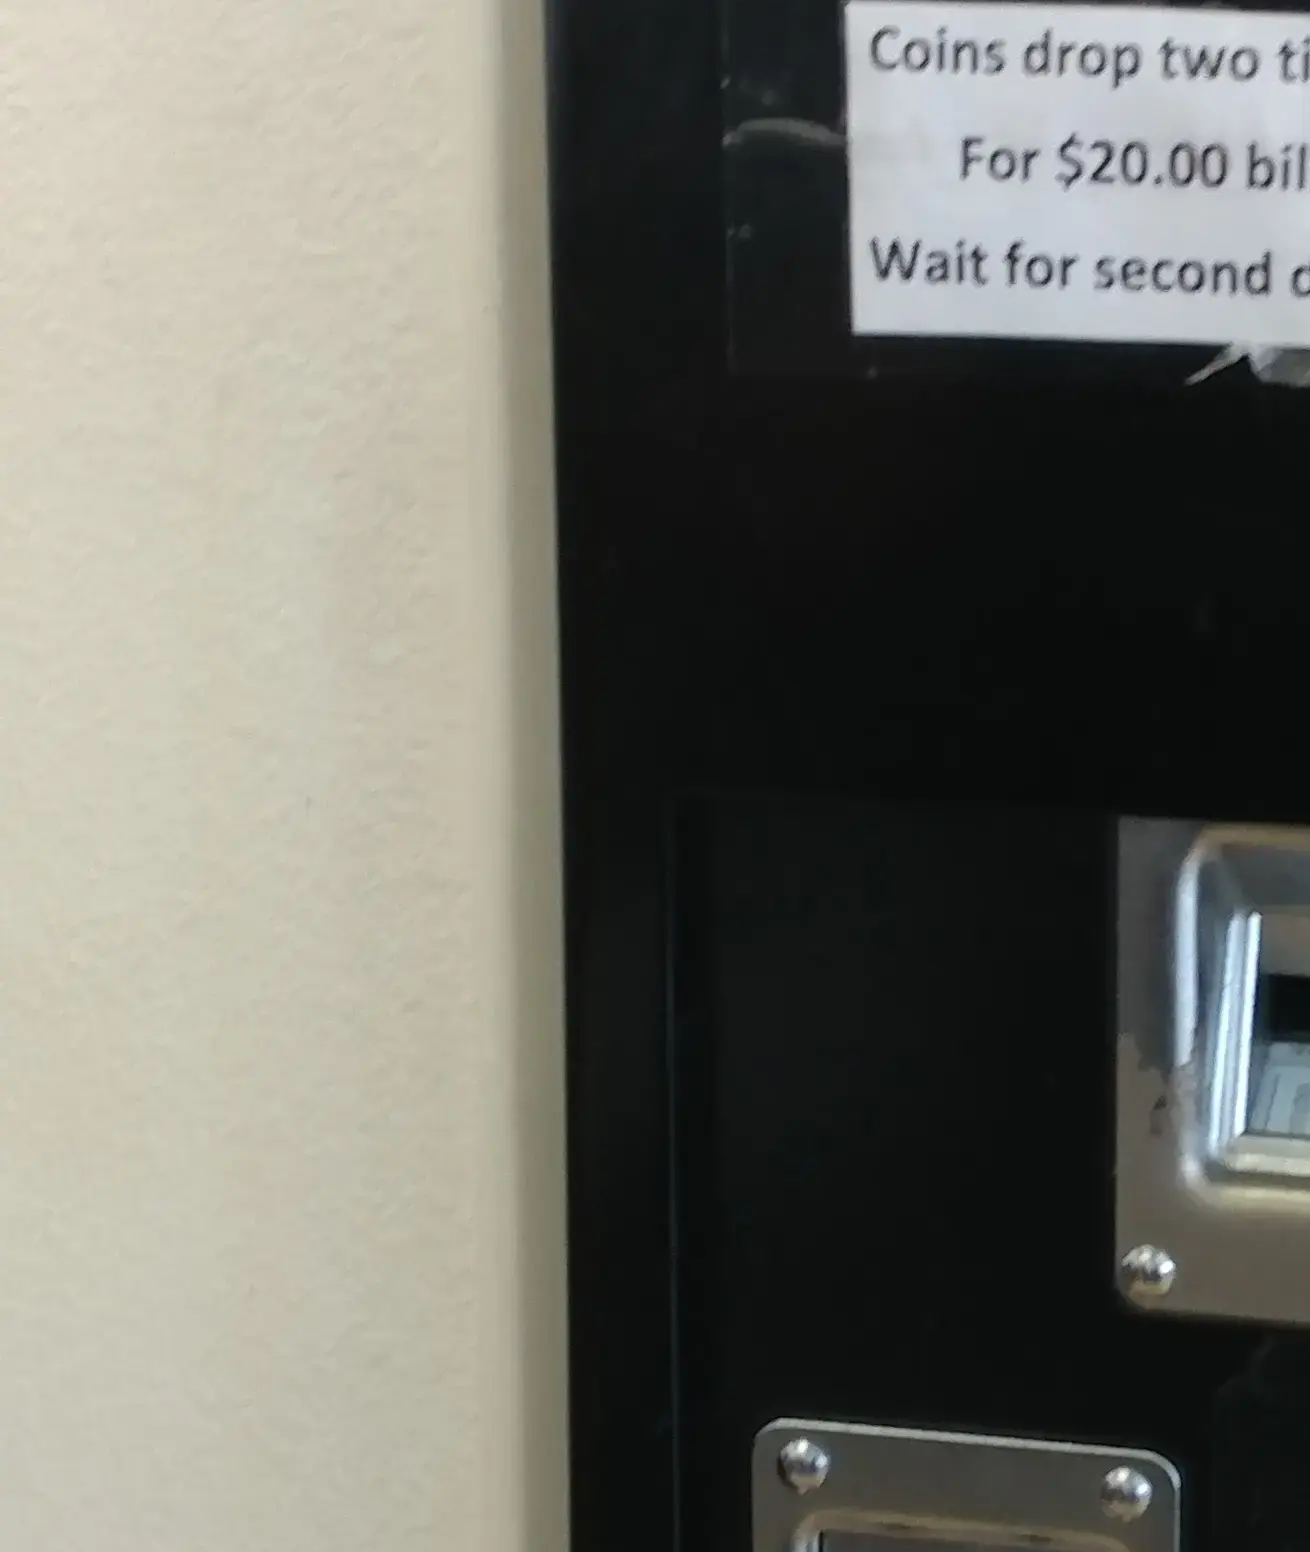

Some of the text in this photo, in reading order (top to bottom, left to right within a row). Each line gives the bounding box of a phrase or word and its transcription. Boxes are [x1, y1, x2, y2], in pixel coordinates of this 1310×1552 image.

[870, 27, 1005, 74] Coins
[1023, 30, 1140, 89] drop
[1160, 39, 1259, 81] two
[960, 137, 1040, 181] For
[1056, 133, 1229, 190] $20.00
[869, 237, 988, 286] Wait
[1004, 241, 1077, 288] for
[1094, 251, 1272, 296] second
